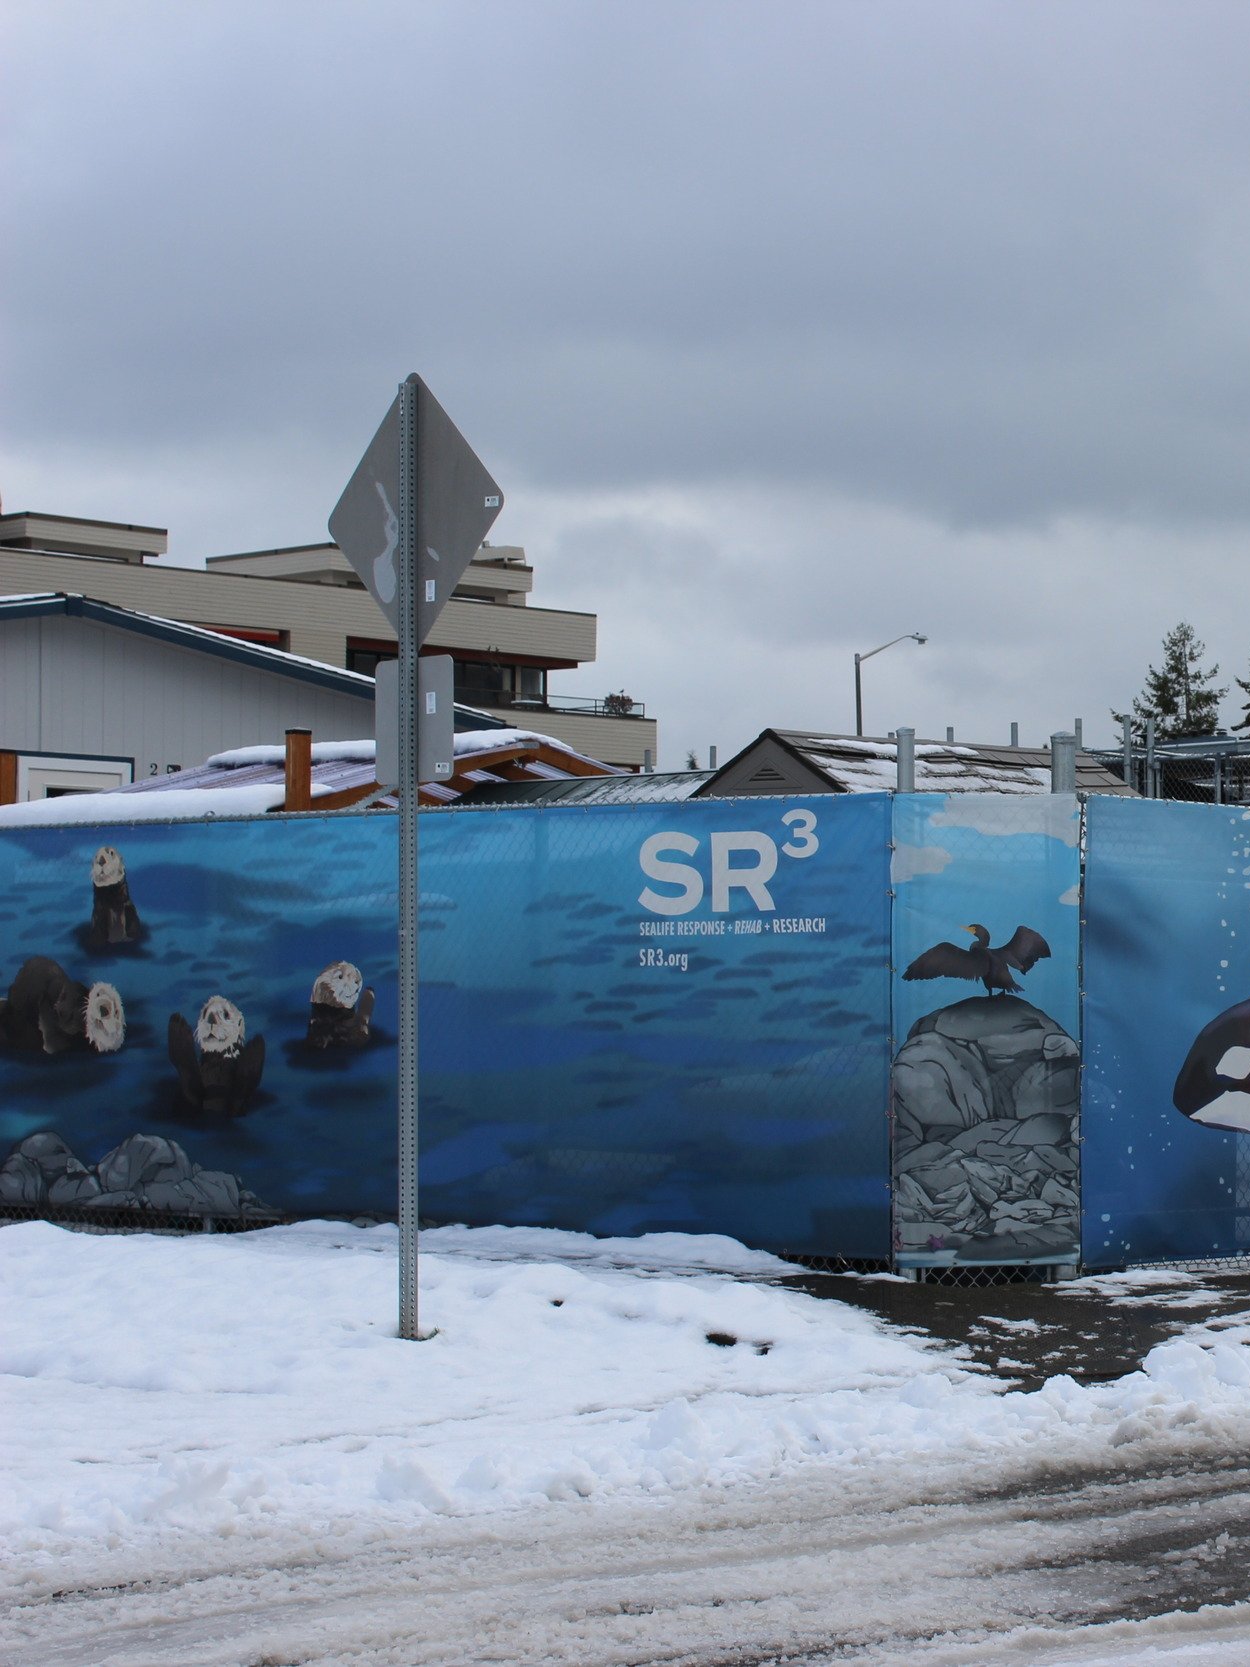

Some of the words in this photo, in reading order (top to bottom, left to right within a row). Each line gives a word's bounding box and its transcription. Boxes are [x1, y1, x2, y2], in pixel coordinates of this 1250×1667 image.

[639, 921, 675, 936] SEALIFE
[677, 920, 726, 935] RESPONSE
[734, 919, 763, 934] REHAB
[772, 917, 826, 933] RESEARCH
[639, 948, 689, 971] SR3.org
